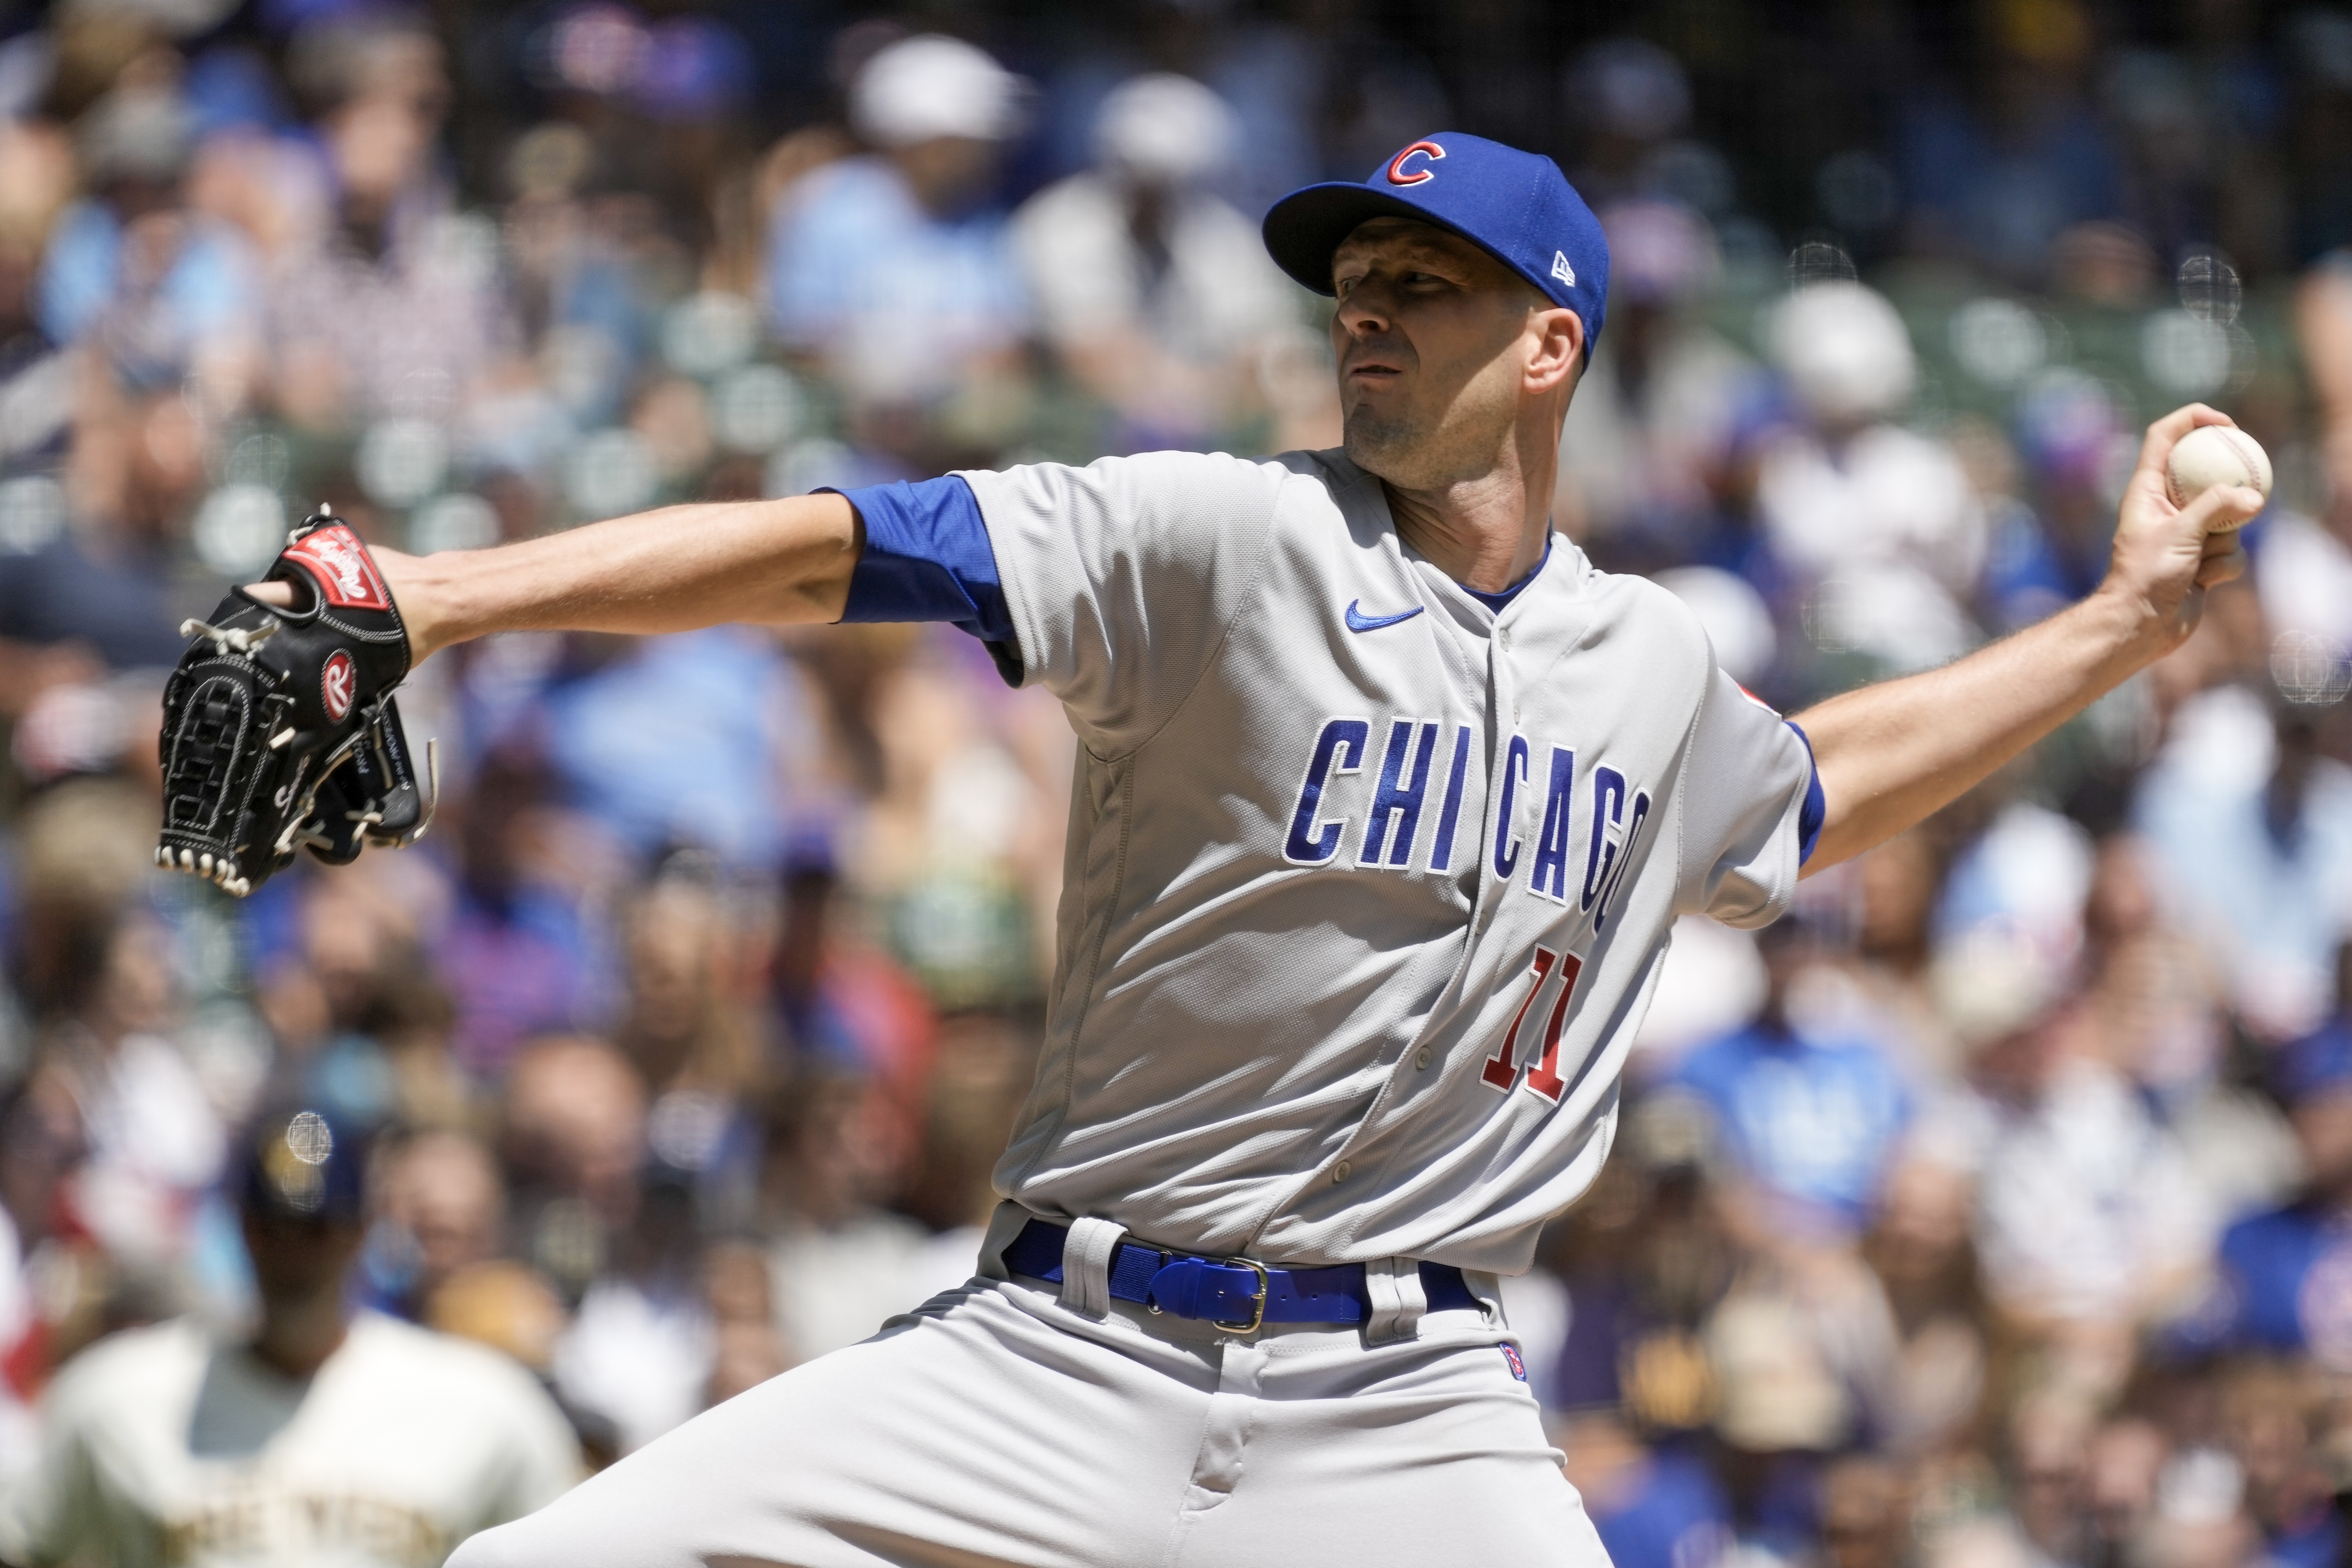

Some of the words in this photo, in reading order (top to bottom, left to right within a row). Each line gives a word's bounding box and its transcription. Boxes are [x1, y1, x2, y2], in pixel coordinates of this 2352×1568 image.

[1387, 141, 1446, 187] C
[1281, 715, 1652, 938] CHICAGO
[1480, 943, 1584, 1106] 11
